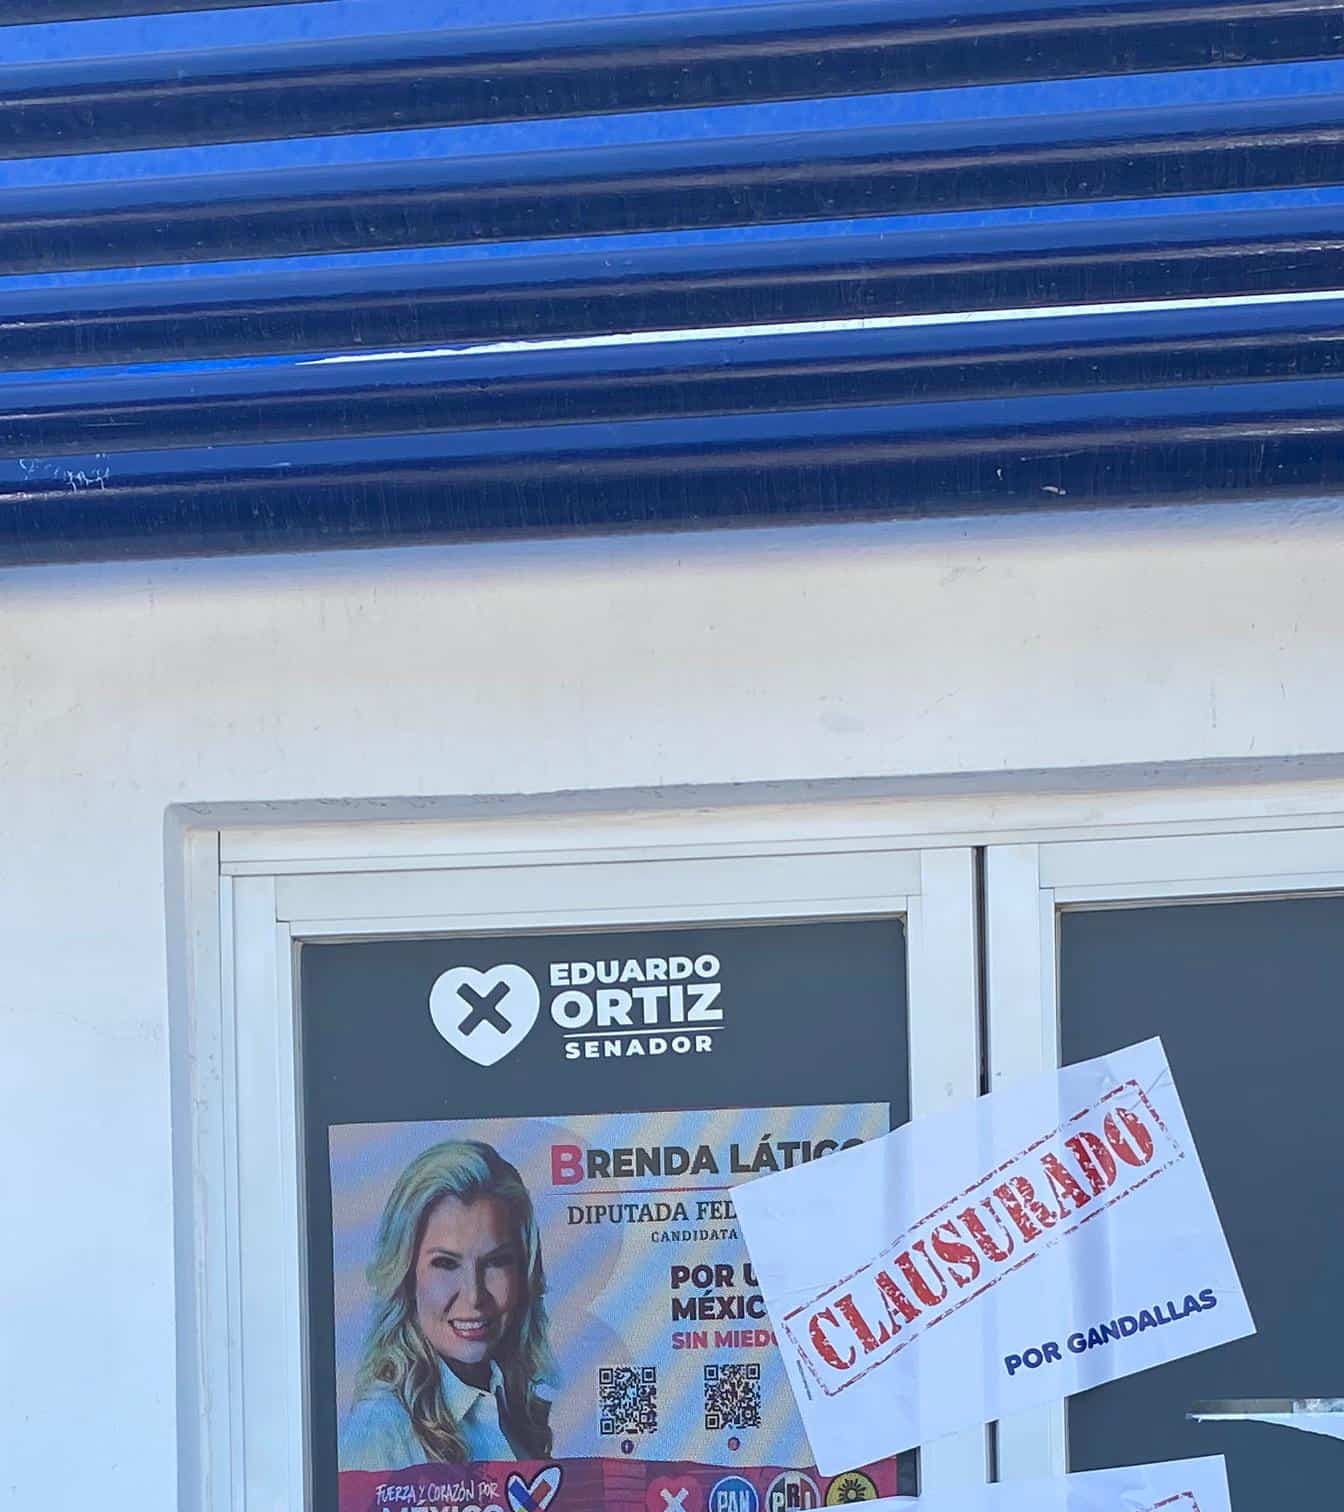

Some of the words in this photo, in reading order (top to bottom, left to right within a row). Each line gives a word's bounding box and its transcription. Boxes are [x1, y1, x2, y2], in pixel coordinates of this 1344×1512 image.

[550, 954, 721, 986] EDUARDO
[550, 982, 724, 1029] ORTIZ
[564, 1035, 713, 1059] SENADOR
[551, 1144, 720, 1185] BRENDA
[567, 1202, 689, 1225] DIPUTADA
[651, 1229, 738, 1242] CANDIDATA
[807, 1106, 1155, 1371] CLAUSURADO
[670, 1263, 735, 1289] POR
[671, 1290, 768, 1321] MÉXIC
[671, 1331, 707, 1350] SIN
[1004, 1341, 1062, 1375] POR
[1067, 1288, 1218, 1355] GANDALLAS
[376, 1484, 416, 1505] FUERZA
[427, 1480, 474, 1502] CORAZÓN
[478, 1481, 500, 1502] POR
